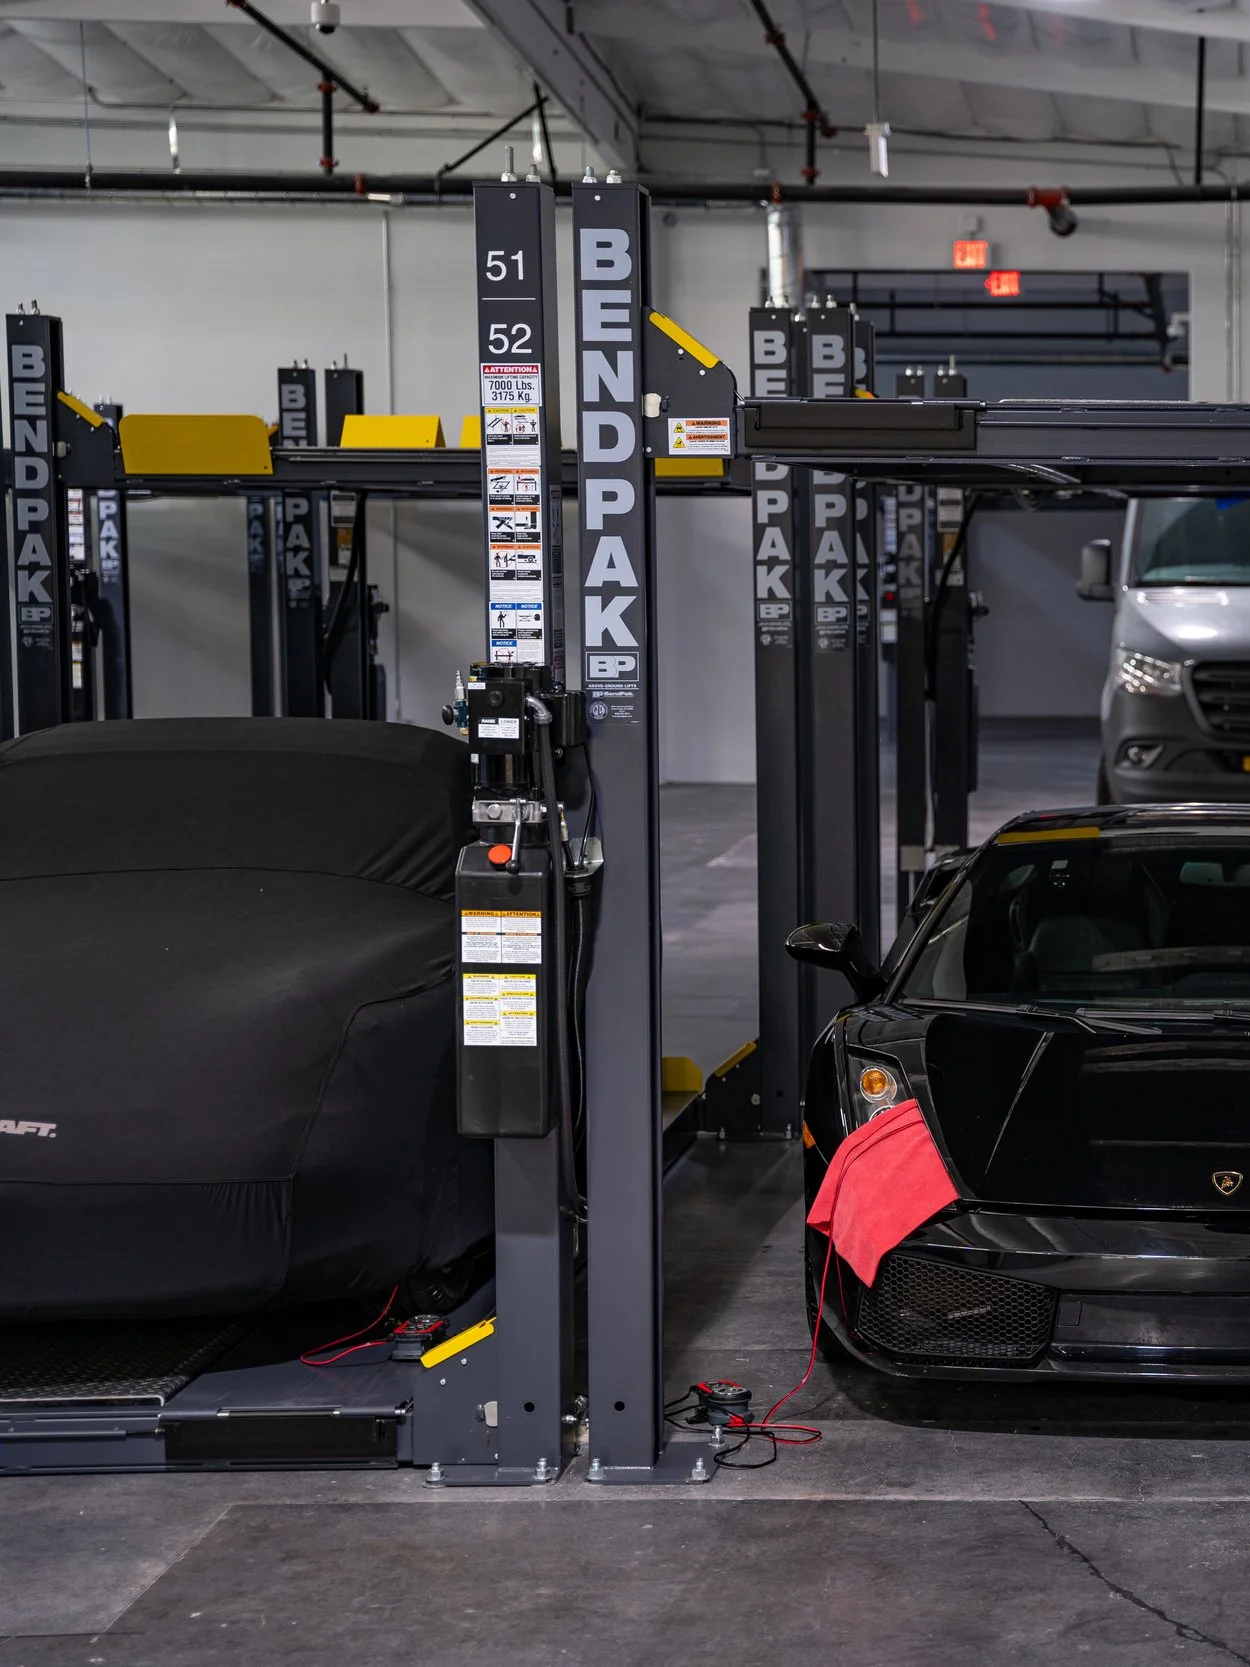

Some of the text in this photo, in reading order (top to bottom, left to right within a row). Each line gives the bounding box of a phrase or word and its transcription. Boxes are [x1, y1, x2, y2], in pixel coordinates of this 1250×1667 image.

[486, 250, 524, 281] 51
[488, 323, 532, 354] 52
[488, 380, 535, 391] 7000 Lbs.
[491, 391, 533, 403] 3175 Kg.
[580, 229, 639, 647] BENDPAK
[12, 344, 52, 603] BENDPAK
[21, 607, 50, 622] BP
[589, 655, 636, 678] BP
